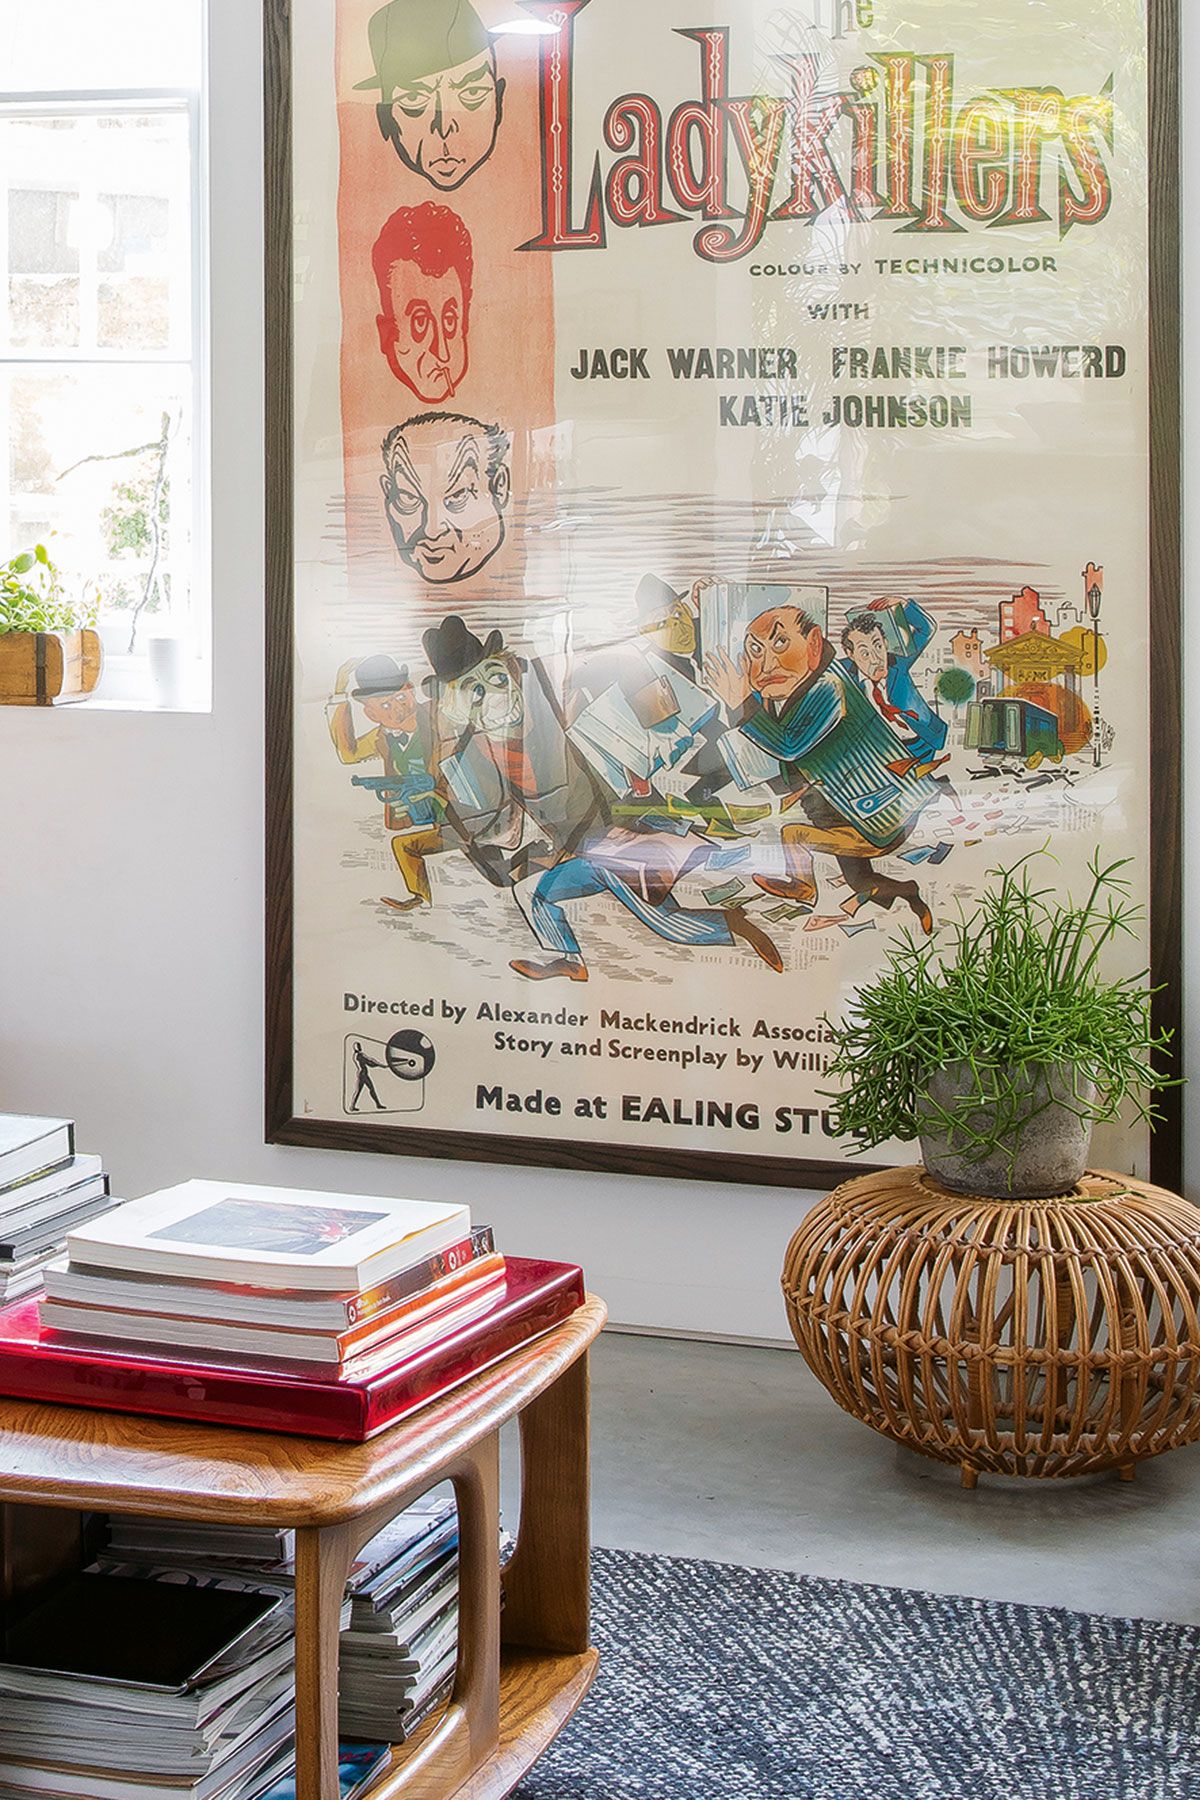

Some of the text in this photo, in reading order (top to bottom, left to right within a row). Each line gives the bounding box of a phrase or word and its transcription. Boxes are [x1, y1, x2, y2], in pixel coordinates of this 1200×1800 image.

[805, 0, 874, 40] he
[514, 0, 1114, 261] Ladykillers
[749, 256, 1058, 277] COLOUR BY TECHNICOLOR
[807, 303, 870, 321] WITH
[570, 345, 1127, 380] JACK WARNER FRANKIE HOWERD
[719, 395, 972, 428] KATIE JOHNSON
[344, 993, 840, 1045] Directed by Alexander Mackendrick Associa
[493, 1031, 834, 1073] Story and Screenplay by Willi
[475, 1085, 562, 1116] Made
[573, 1094, 608, 1120] at
[621, 1094, 760, 1131] EALING
